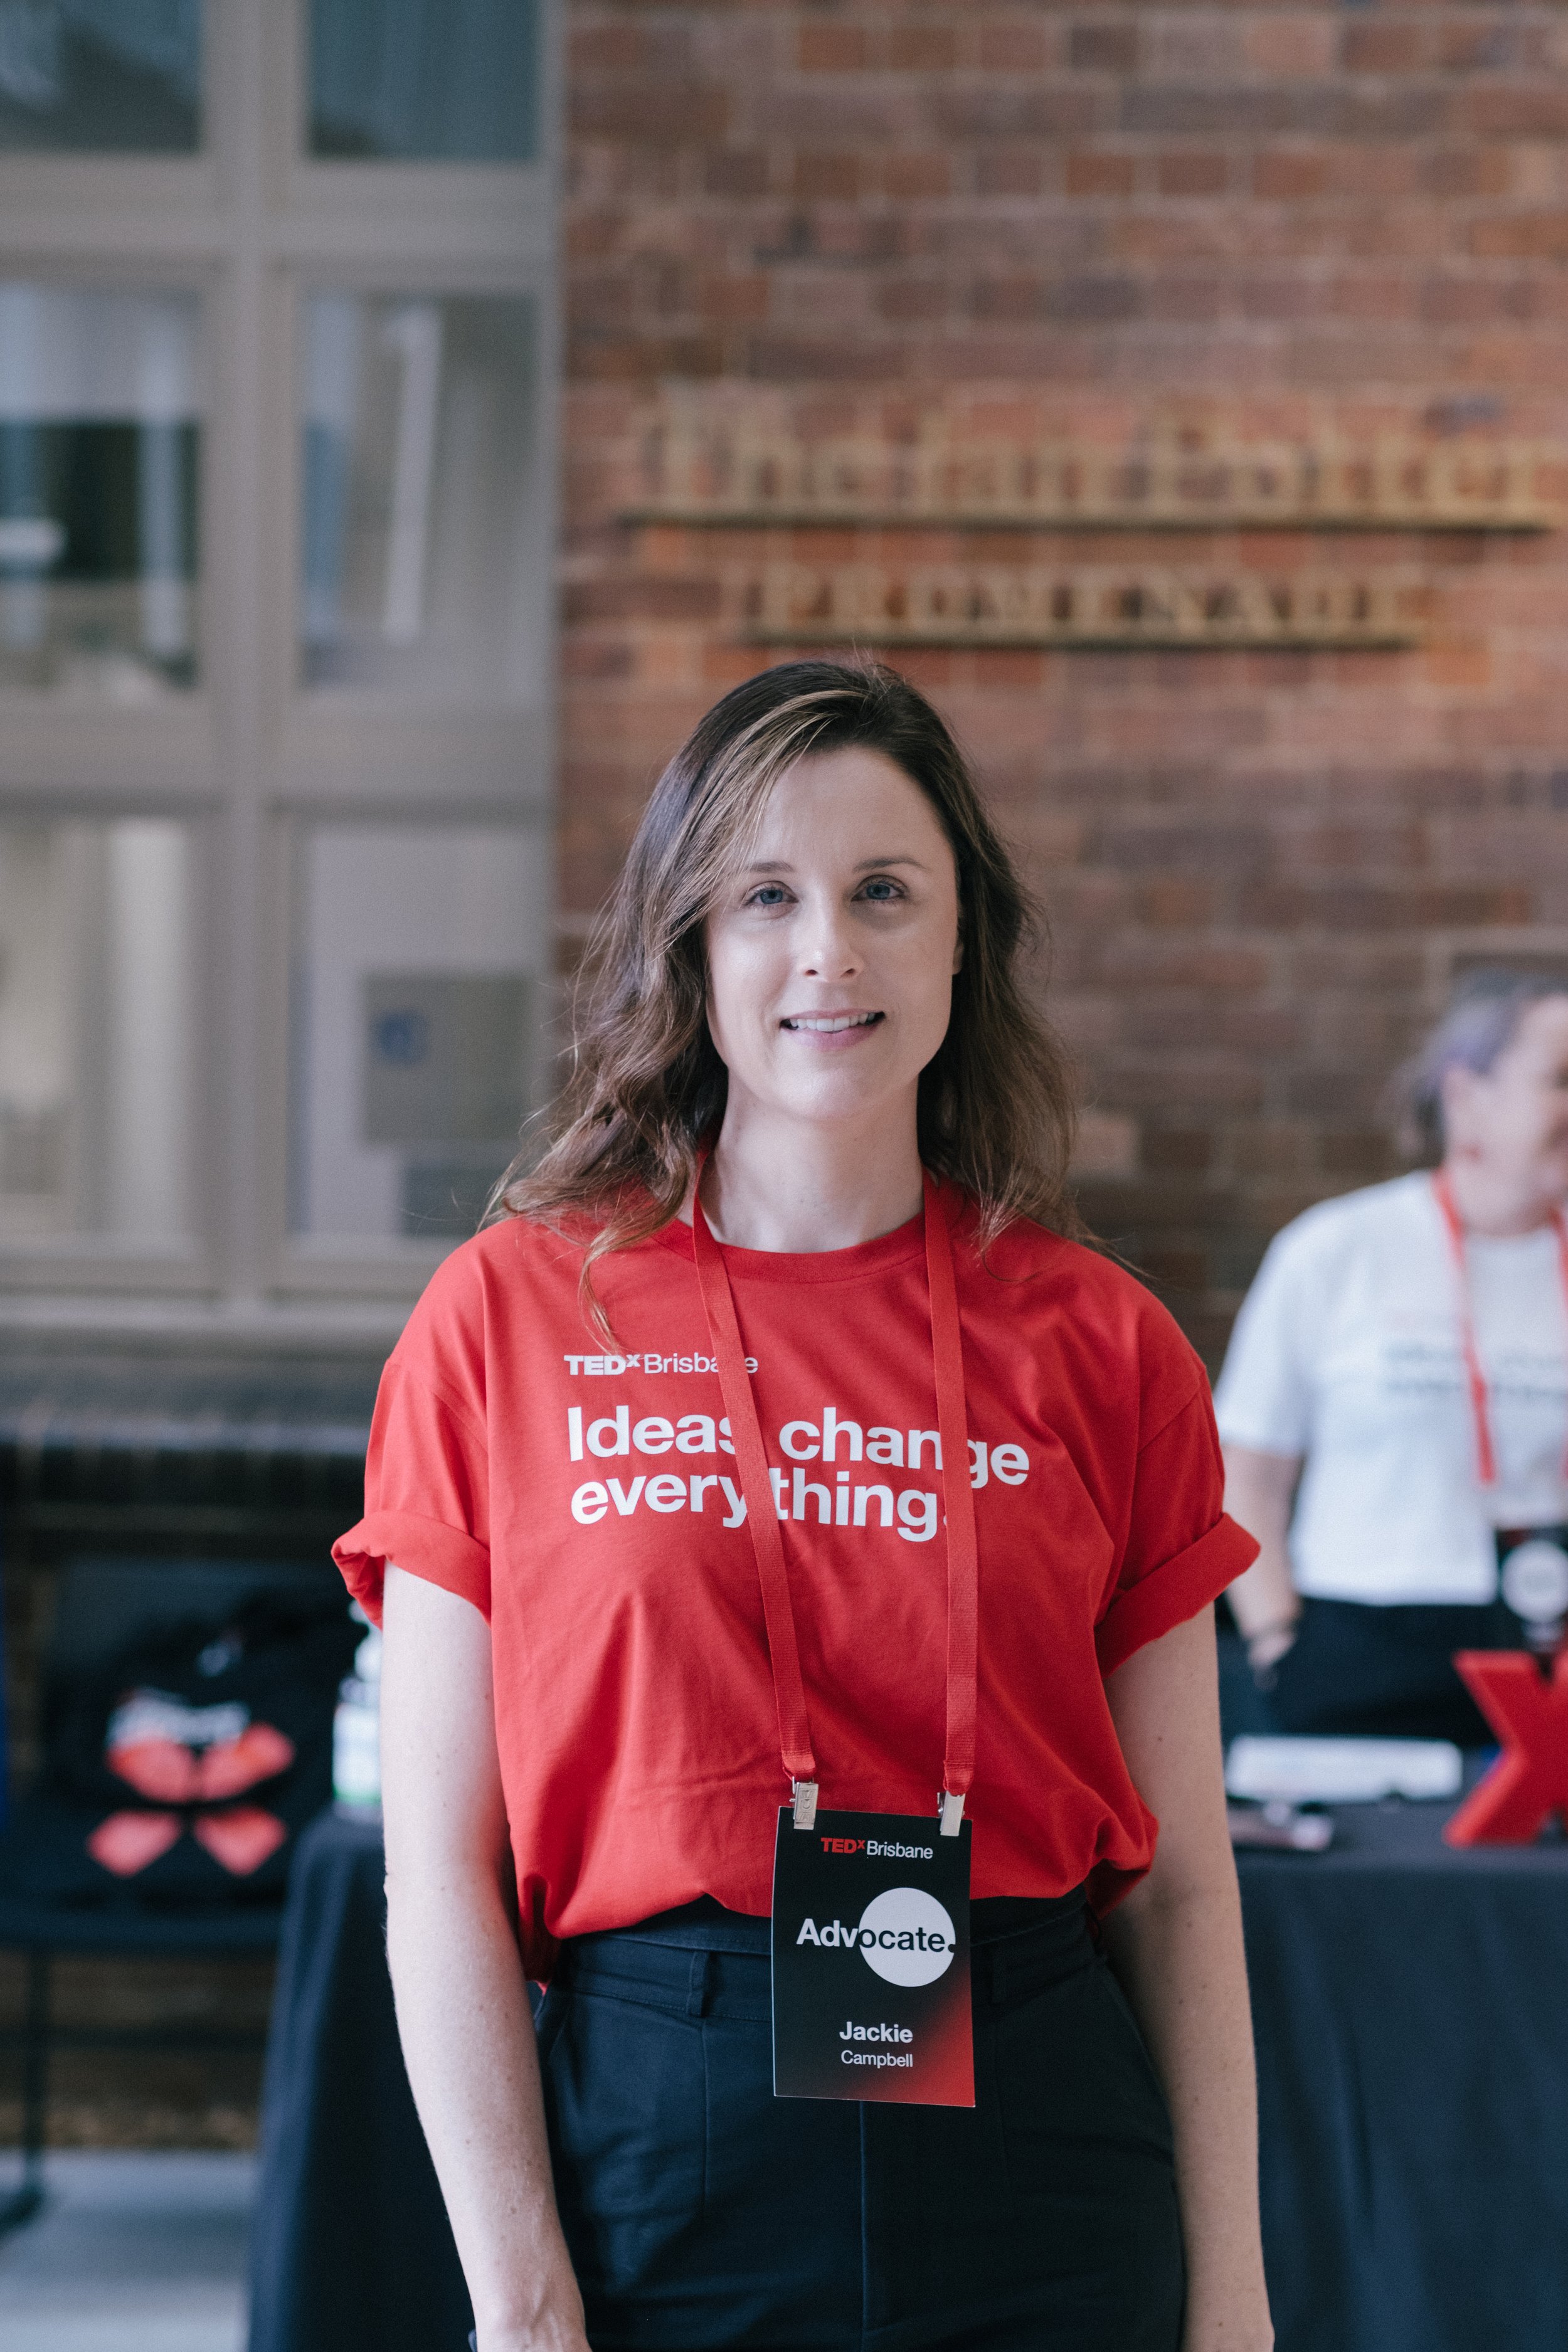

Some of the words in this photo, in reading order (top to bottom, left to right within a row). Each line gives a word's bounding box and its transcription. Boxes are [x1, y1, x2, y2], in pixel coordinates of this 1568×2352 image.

[563, 1352, 758, 1375] TEDxBrisbe
[571, 1468, 948, 1542] everything
[820, 1837, 933, 1859] TEDxBrisbane
[839, 2021, 913, 2043] Jackie
[840, 2050, 913, 2069] Campbell
